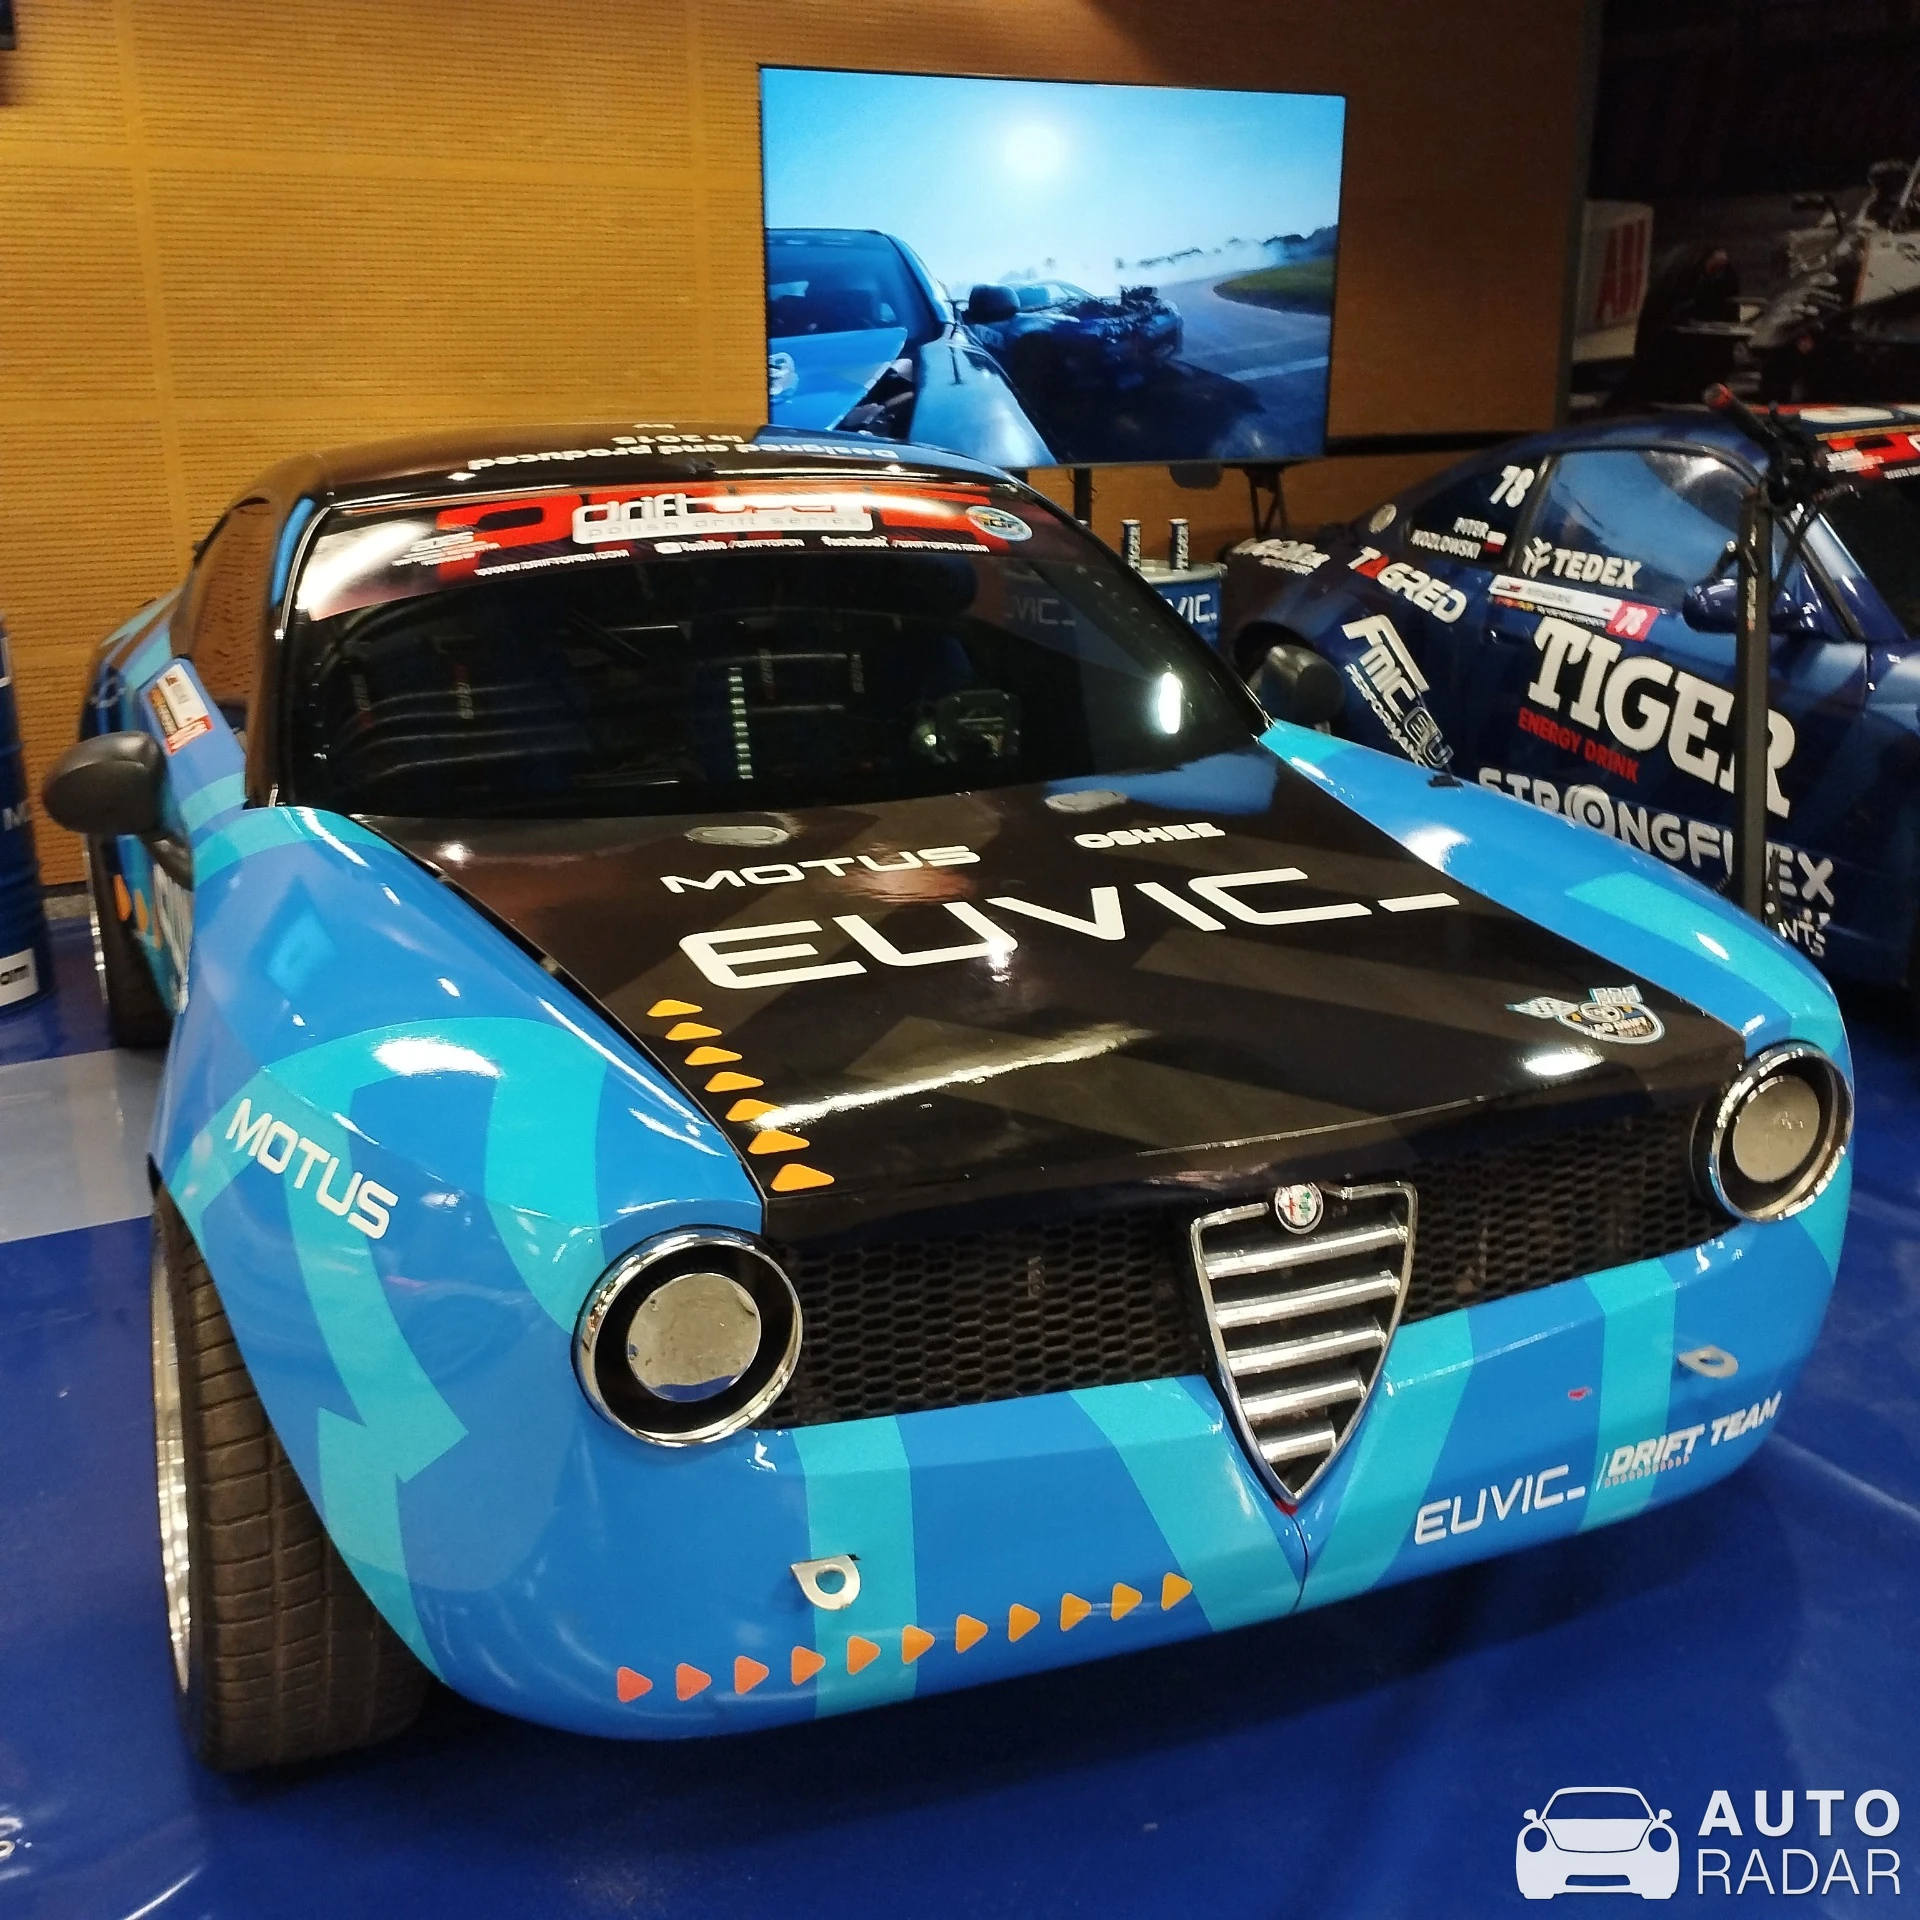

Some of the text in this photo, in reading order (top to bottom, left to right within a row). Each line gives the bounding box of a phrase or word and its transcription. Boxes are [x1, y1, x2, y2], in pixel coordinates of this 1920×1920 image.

[467, 443, 899, 471] Designed and produced
[572, 493, 688, 523] drift
[1551, 547, 1642, 590] TEDEX
[1518, 707, 1640, 784] ENERGY DRINK
[1528, 617, 1796, 819] TIGER
[659, 845, 982, 895] MOTUS
[225, 1098, 399, 1239] MOTUS
[1608, 1423, 1706, 1478] DRIFT
[1710, 1390, 1783, 1447] TEAM
